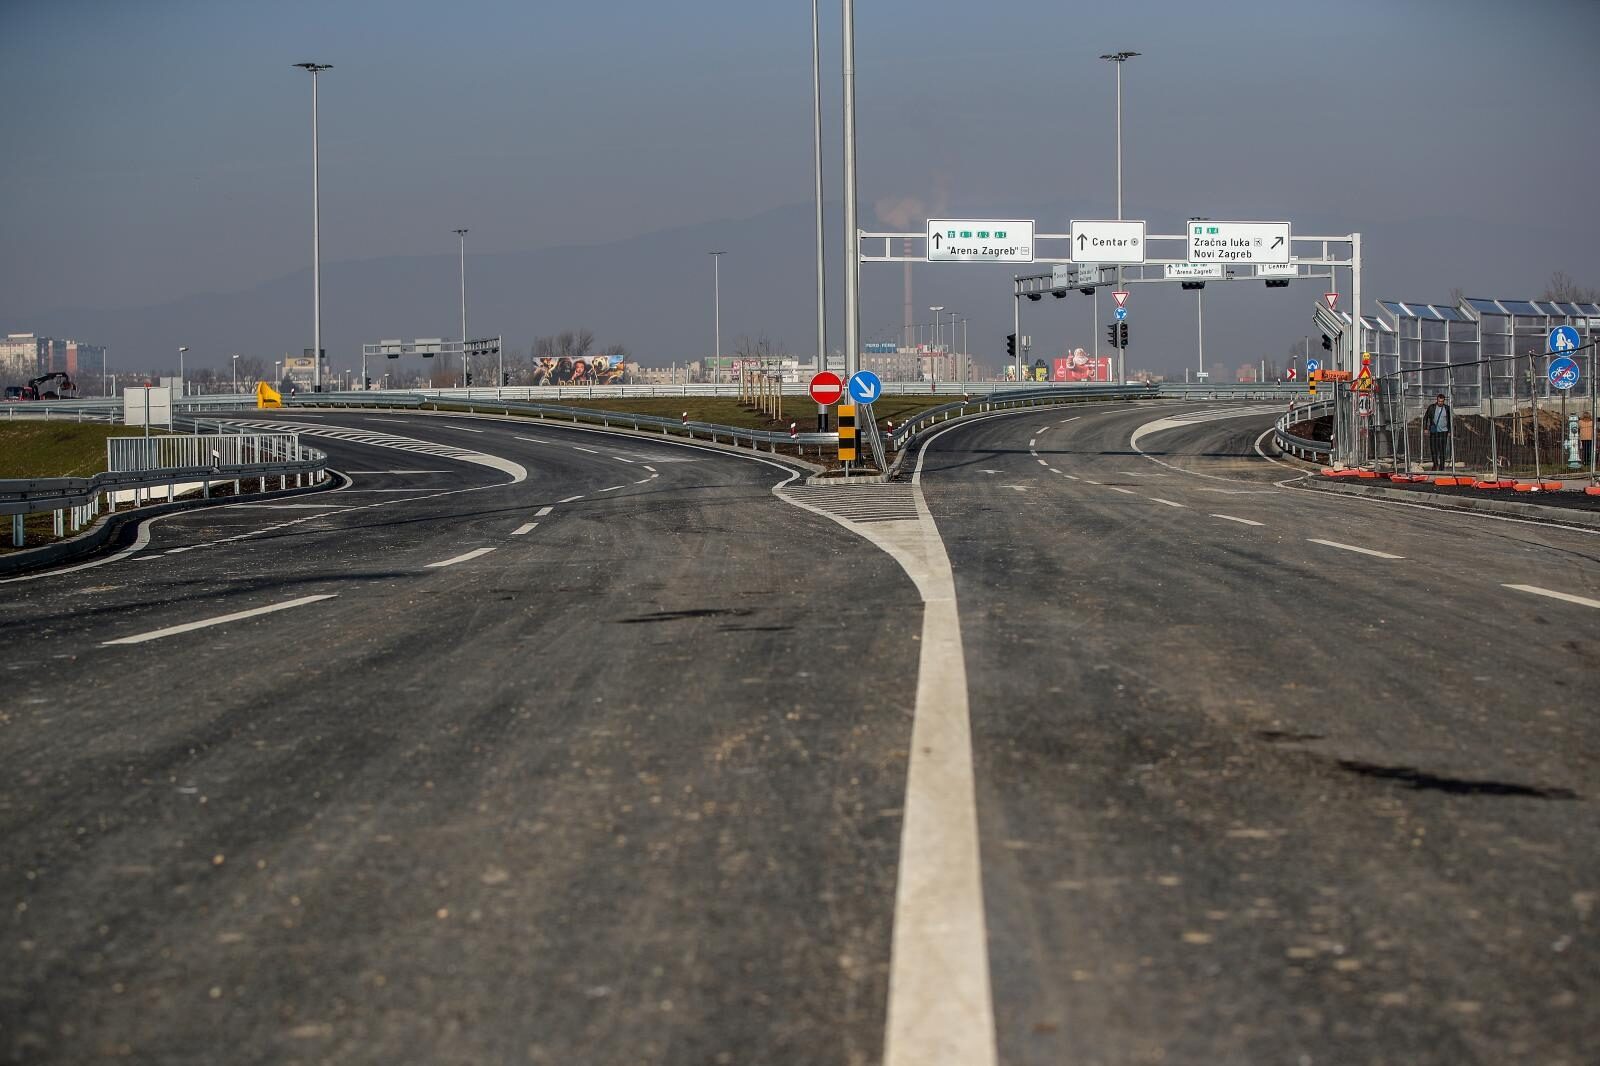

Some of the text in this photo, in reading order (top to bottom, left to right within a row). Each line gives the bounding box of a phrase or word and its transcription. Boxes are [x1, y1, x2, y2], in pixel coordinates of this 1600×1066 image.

[1092, 237, 1128, 247] Centar
[1194, 237, 1250, 247] Zračna luka
[946, 246, 1019, 257] "Arena Zagreb"
[1194, 249, 1252, 260] Novi Zagreb
